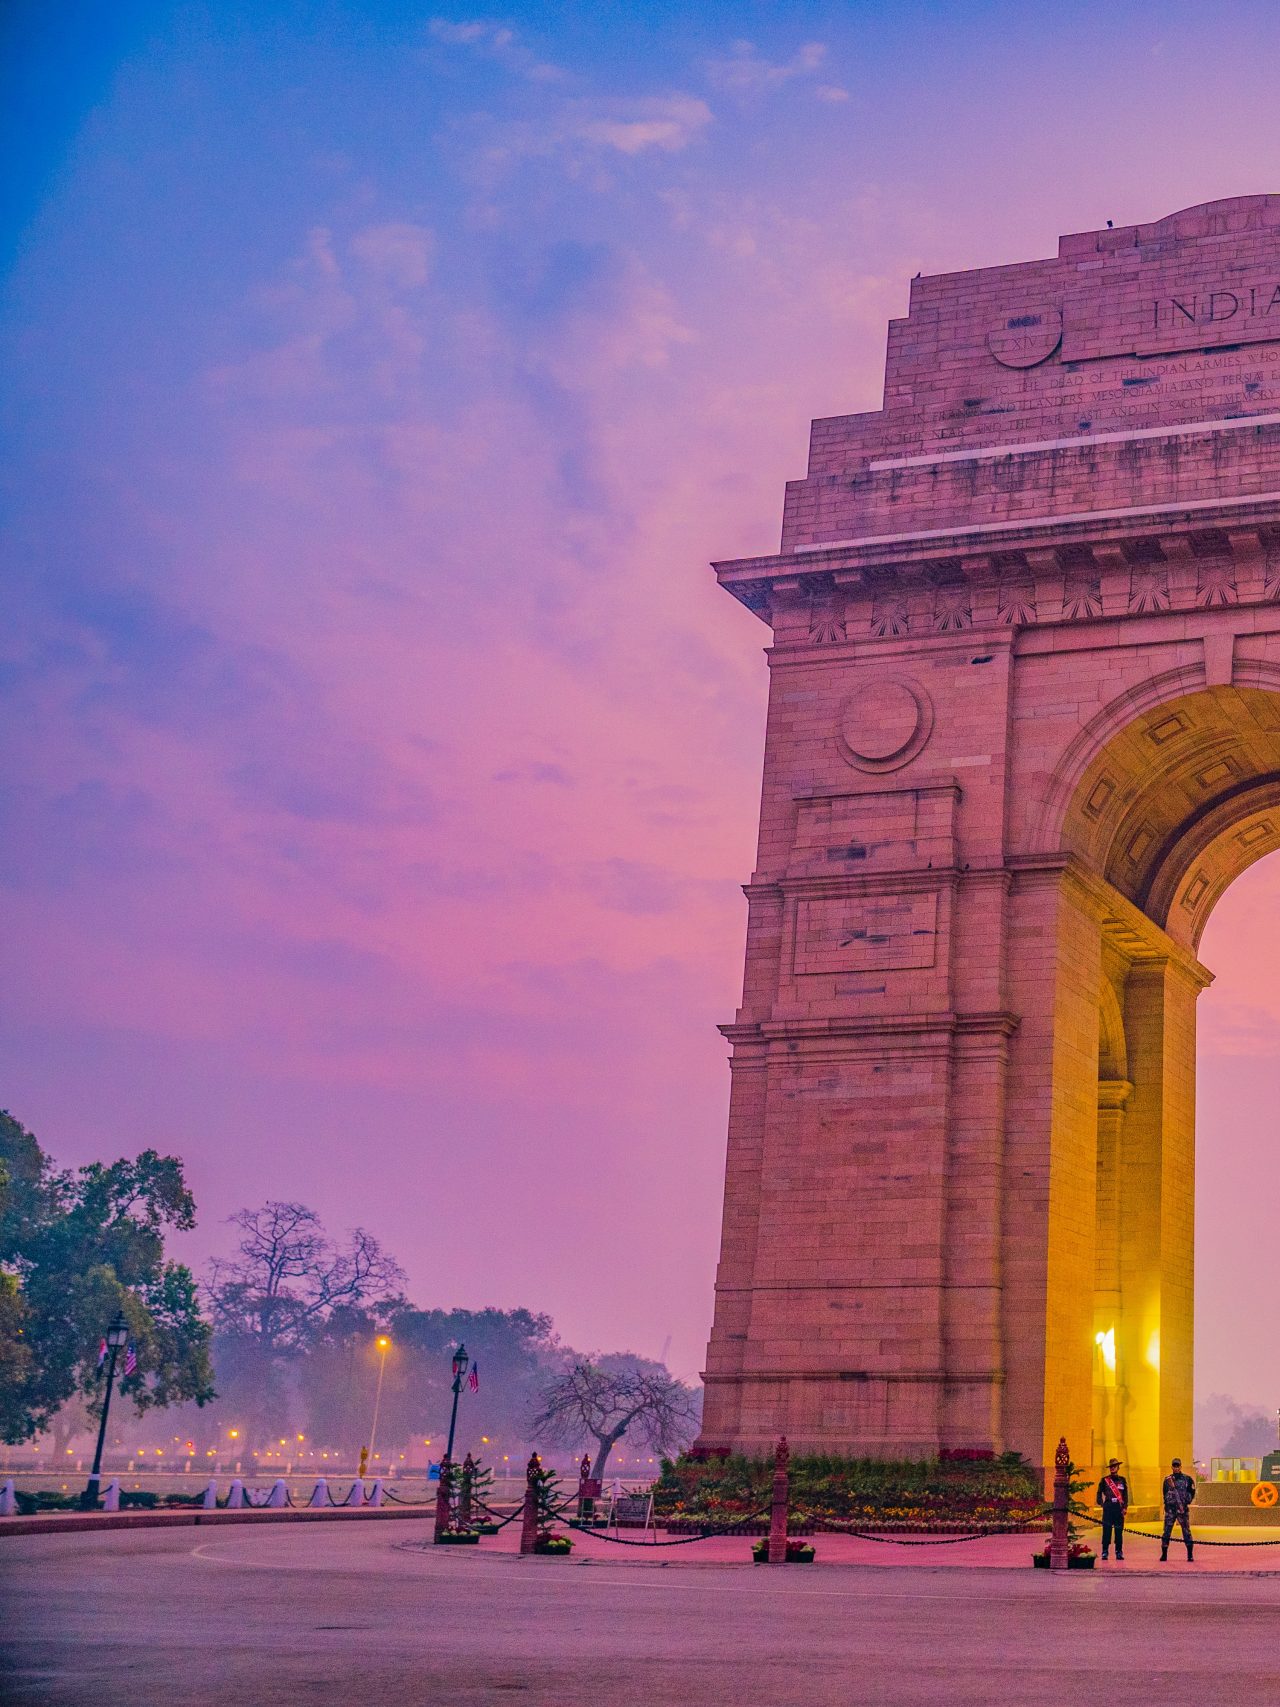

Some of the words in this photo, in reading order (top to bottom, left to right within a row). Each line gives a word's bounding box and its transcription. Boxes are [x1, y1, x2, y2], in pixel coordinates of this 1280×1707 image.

[1009, 315, 1041, 329] MCM
[1012, 336, 1037, 351] XIV
[994, 386, 1009, 396] TO
[1018, 381, 1039, 392] THE
[1050, 376, 1083, 388] DEAD
[1090, 373, 1104, 384] OF
[1114, 369, 1135, 381] THE
[1142, 363, 1187, 377] INDIAN
[1195, 357, 1240, 370] ARMIES
[1248, 351, 1278, 363] WHO
[881, 435, 892, 446] IN
[899, 431, 922, 444] THE
[932, 427, 965, 440] NEAR
[975, 423, 1002, 434] AND
[1009, 418, 1031, 430] THE
[1040, 414, 1063, 426] FAR
[1073, 410, 1103, 422] EAST
[1111, 406, 1137, 418] AND
[1147, 403, 1160, 414] IN
[1169, 395, 1216, 410] SACRED
[1224, 388, 1274, 405] MEMORY
[914, 413, 927, 424] IN
[933, 406, 980, 421] FRANCE
[990, 402, 1015, 413] AND
[1022, 393, 1083, 410] FLANDERS
[1091, 380, 1176, 400] MESOPOTAMIA
[1183, 378, 1214, 391] AND
[1223, 370, 1263, 386] PERSIA
